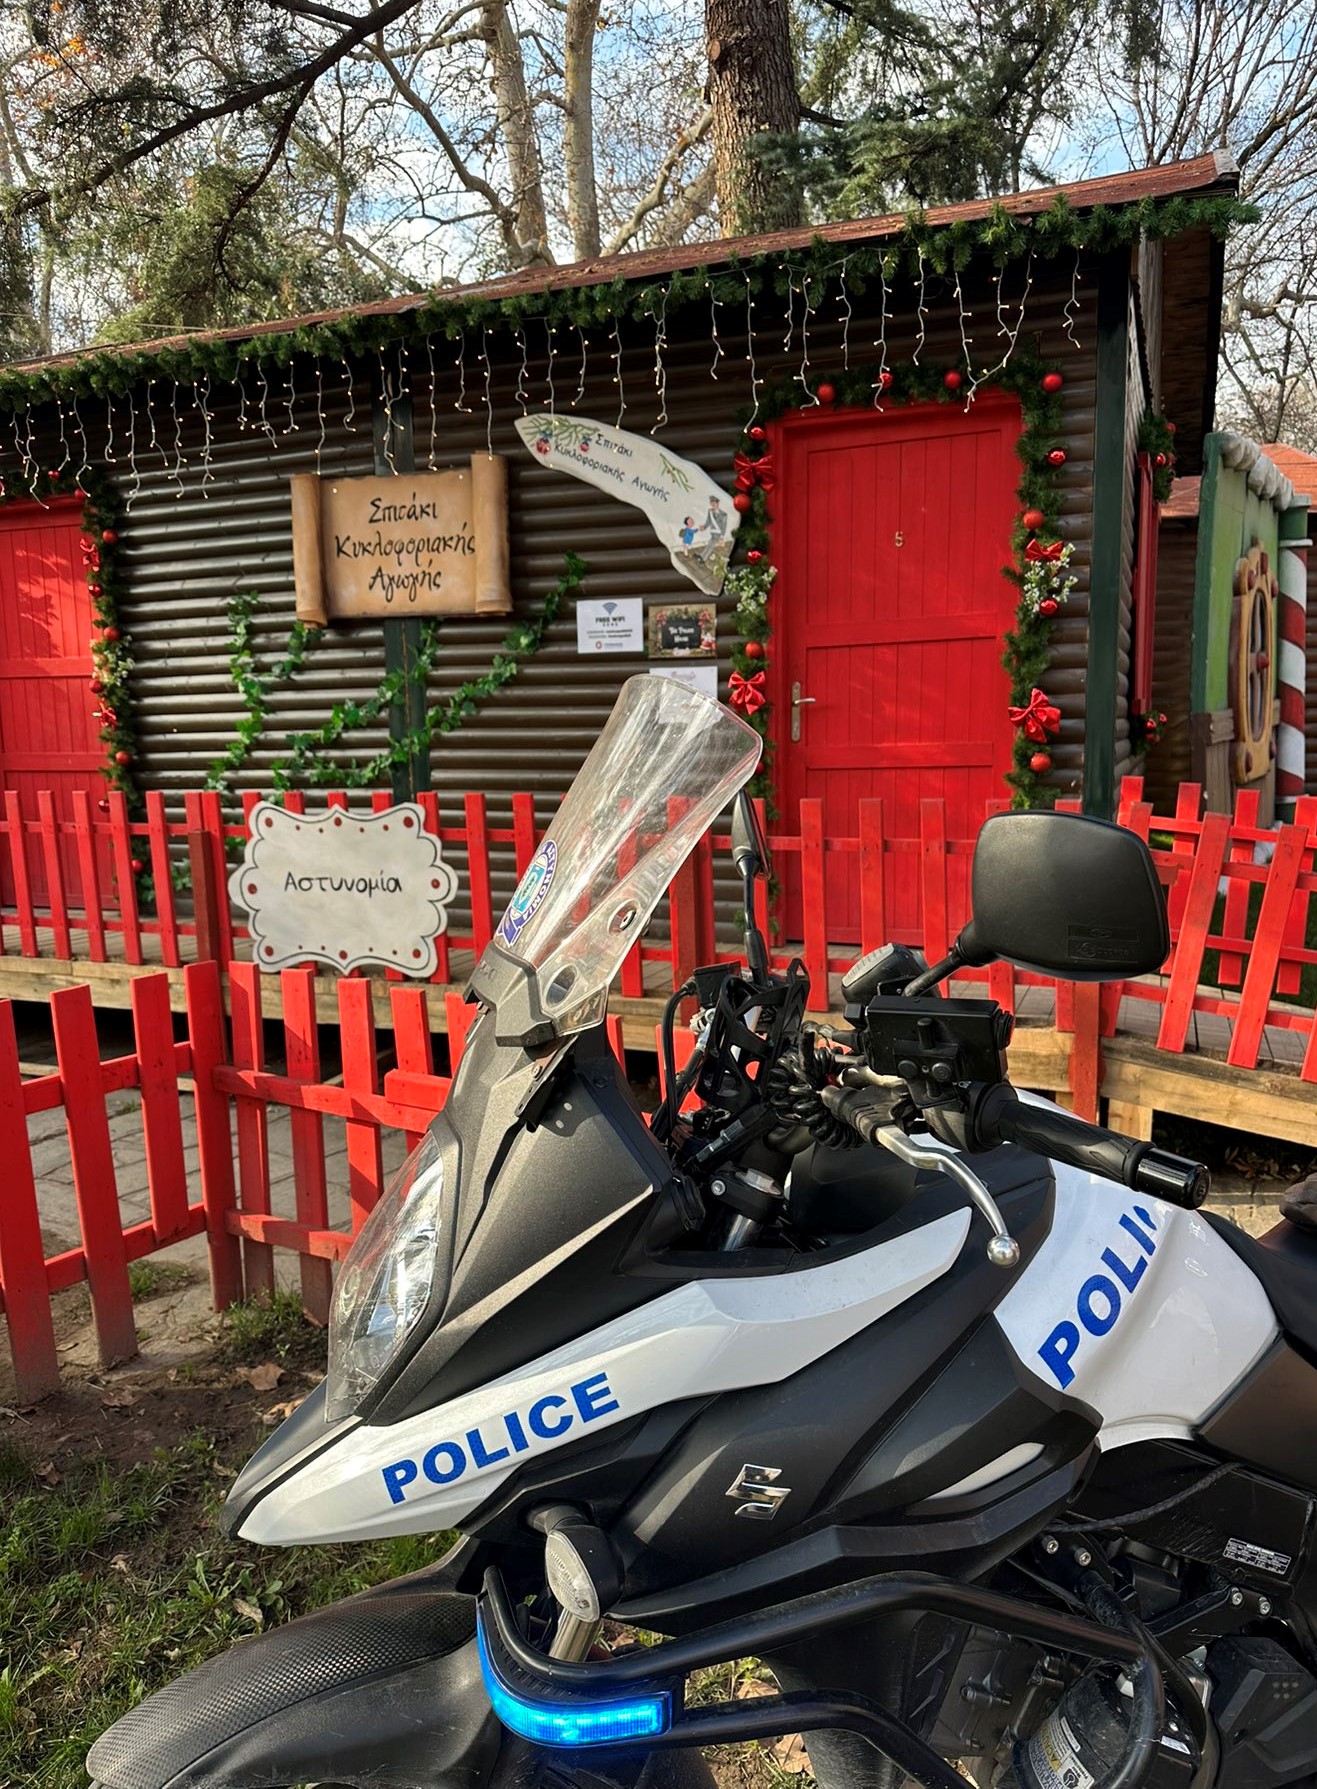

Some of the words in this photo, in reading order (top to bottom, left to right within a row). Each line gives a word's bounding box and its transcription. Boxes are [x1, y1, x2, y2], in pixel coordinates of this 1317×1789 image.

[595, 433, 633, 457] Σπιτάκι
[554, 443, 626, 483] Κυκλοφοριακής
[631, 476, 671, 502] Αγωγής
[335, 522, 476, 566] Κυκλοφοριακής
[368, 559, 442, 603] Αγωγής
[284, 869, 402, 898] Αστυνομία
[381, 1371, 620, 1505] POLICE
